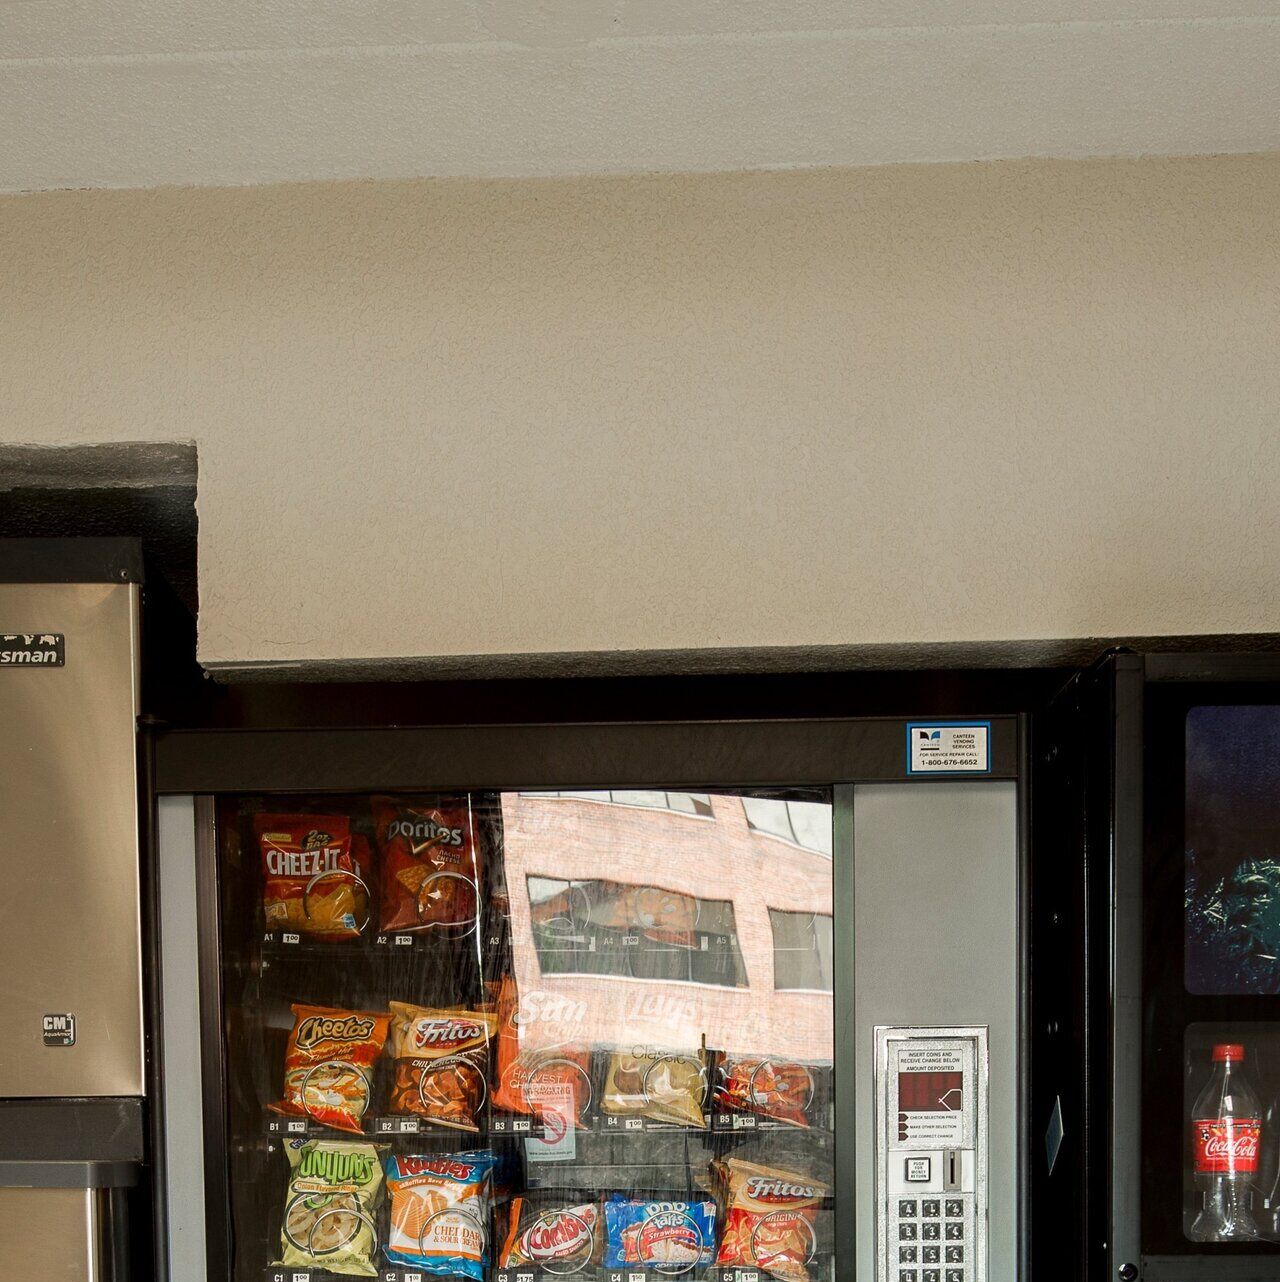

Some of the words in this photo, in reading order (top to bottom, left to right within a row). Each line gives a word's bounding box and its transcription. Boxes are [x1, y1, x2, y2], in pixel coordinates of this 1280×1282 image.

[388, 821, 463, 846] Doritos
[266, 848, 341, 876] CHEEZ-IT
[264, 933, 274, 941] A1
[377, 936, 387, 945] A2
[489, 937, 500, 945] A3
[603, 937, 614, 945] A4
[716, 937, 727, 945] A5
[297, 1017, 373, 1048] Cheetos
[417, 1018, 483, 1046] Fritos
[513, 1070, 563, 1084] HAVEST
[608, 1117, 618, 1126] B4
[720, 1115, 730, 1124] B5
[270, 1122, 279, 1131] B1
[382, 1122, 392, 1131] B2
[495, 1122, 505, 1130] B3
[747, 1176, 816, 1199] Fritos
[649, 1228, 691, 1240] Strawberry
[274, 1274, 284, 1282] C1
[386, 1273, 396, 1282] C2
[498, 1274, 508, 1282] C3
[611, 1274, 621, 1282] C4
[723, 1273, 733, 1282] C5
